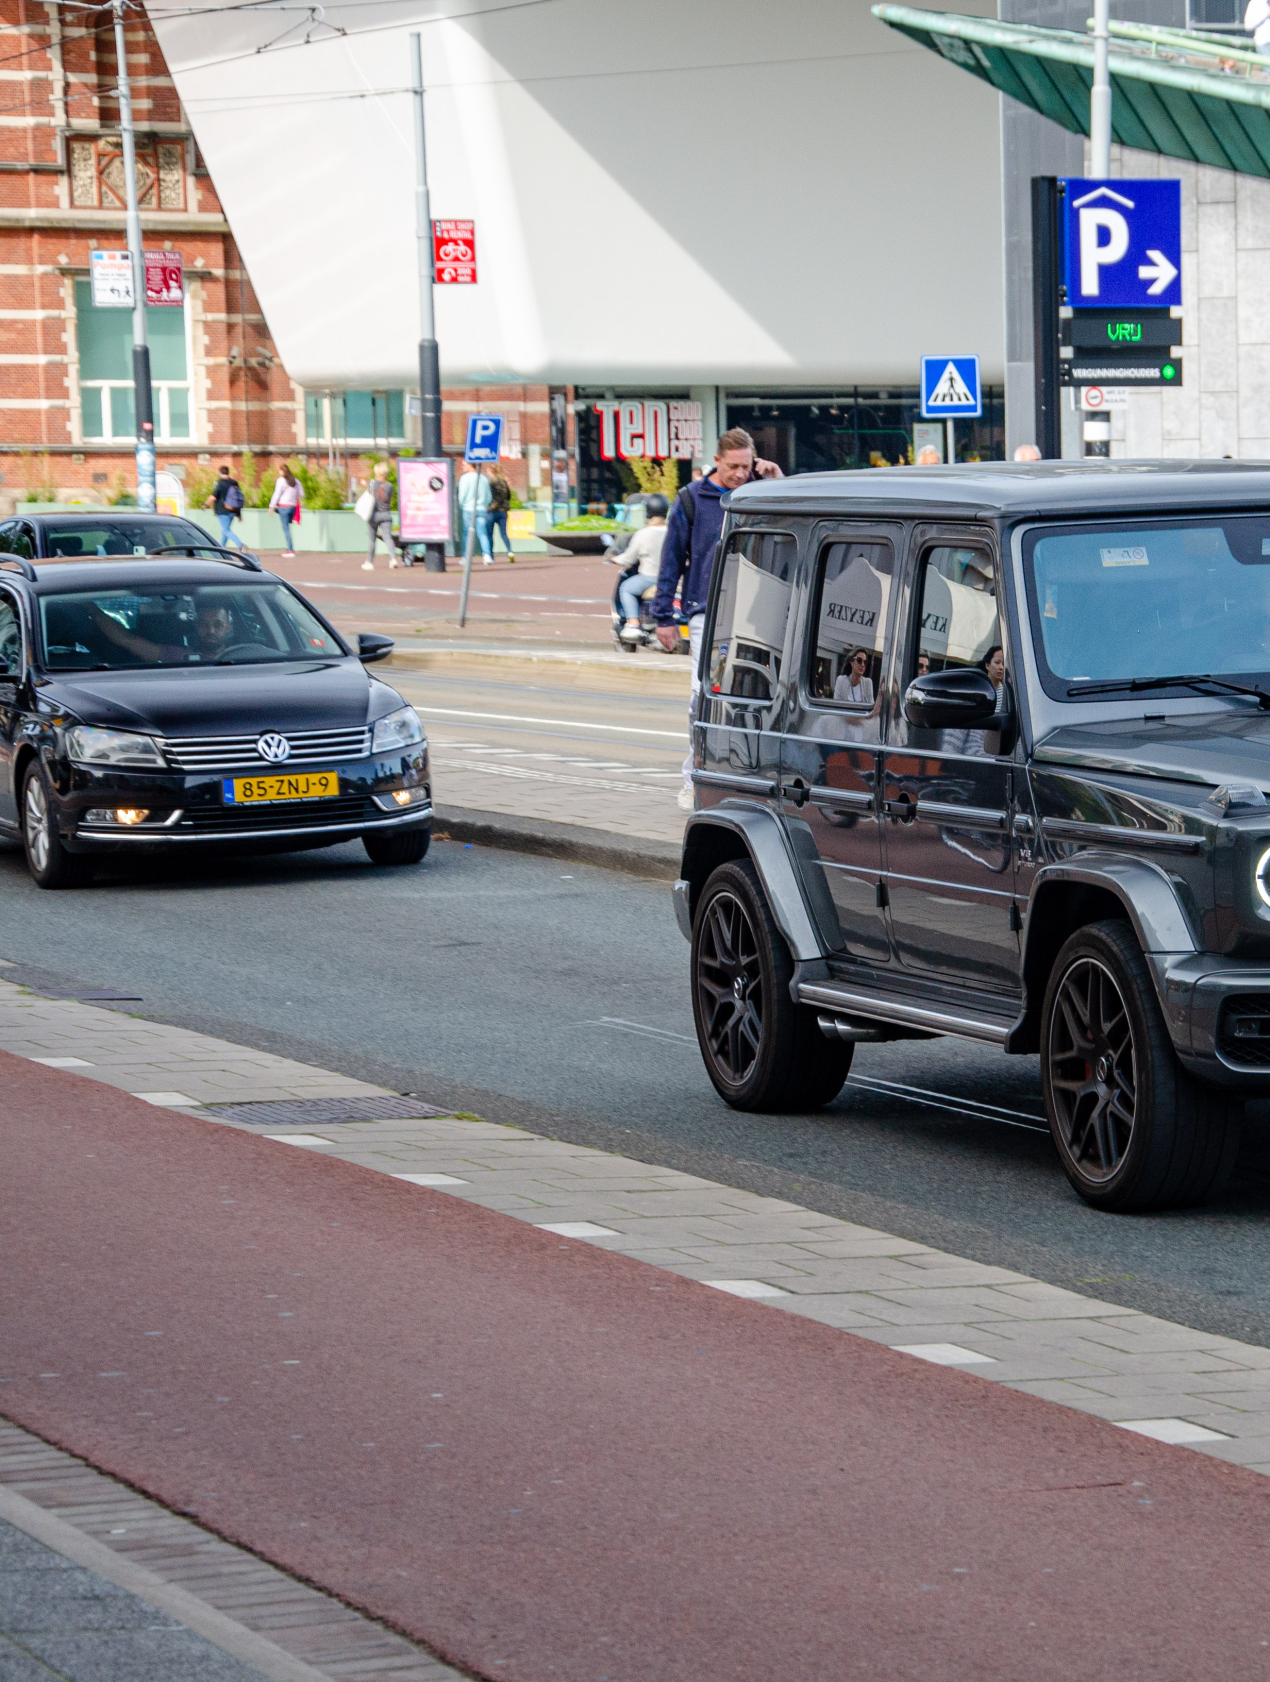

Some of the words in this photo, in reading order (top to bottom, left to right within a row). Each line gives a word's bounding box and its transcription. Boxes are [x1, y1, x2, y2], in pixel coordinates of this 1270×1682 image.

[1079, 207, 1129, 297] P
[1071, 367, 1160, 379] VERGUNNINGHOUDERS
[475, 420, 496, 444] P
[242, 775, 331, 800] 85-ZNJ-9
